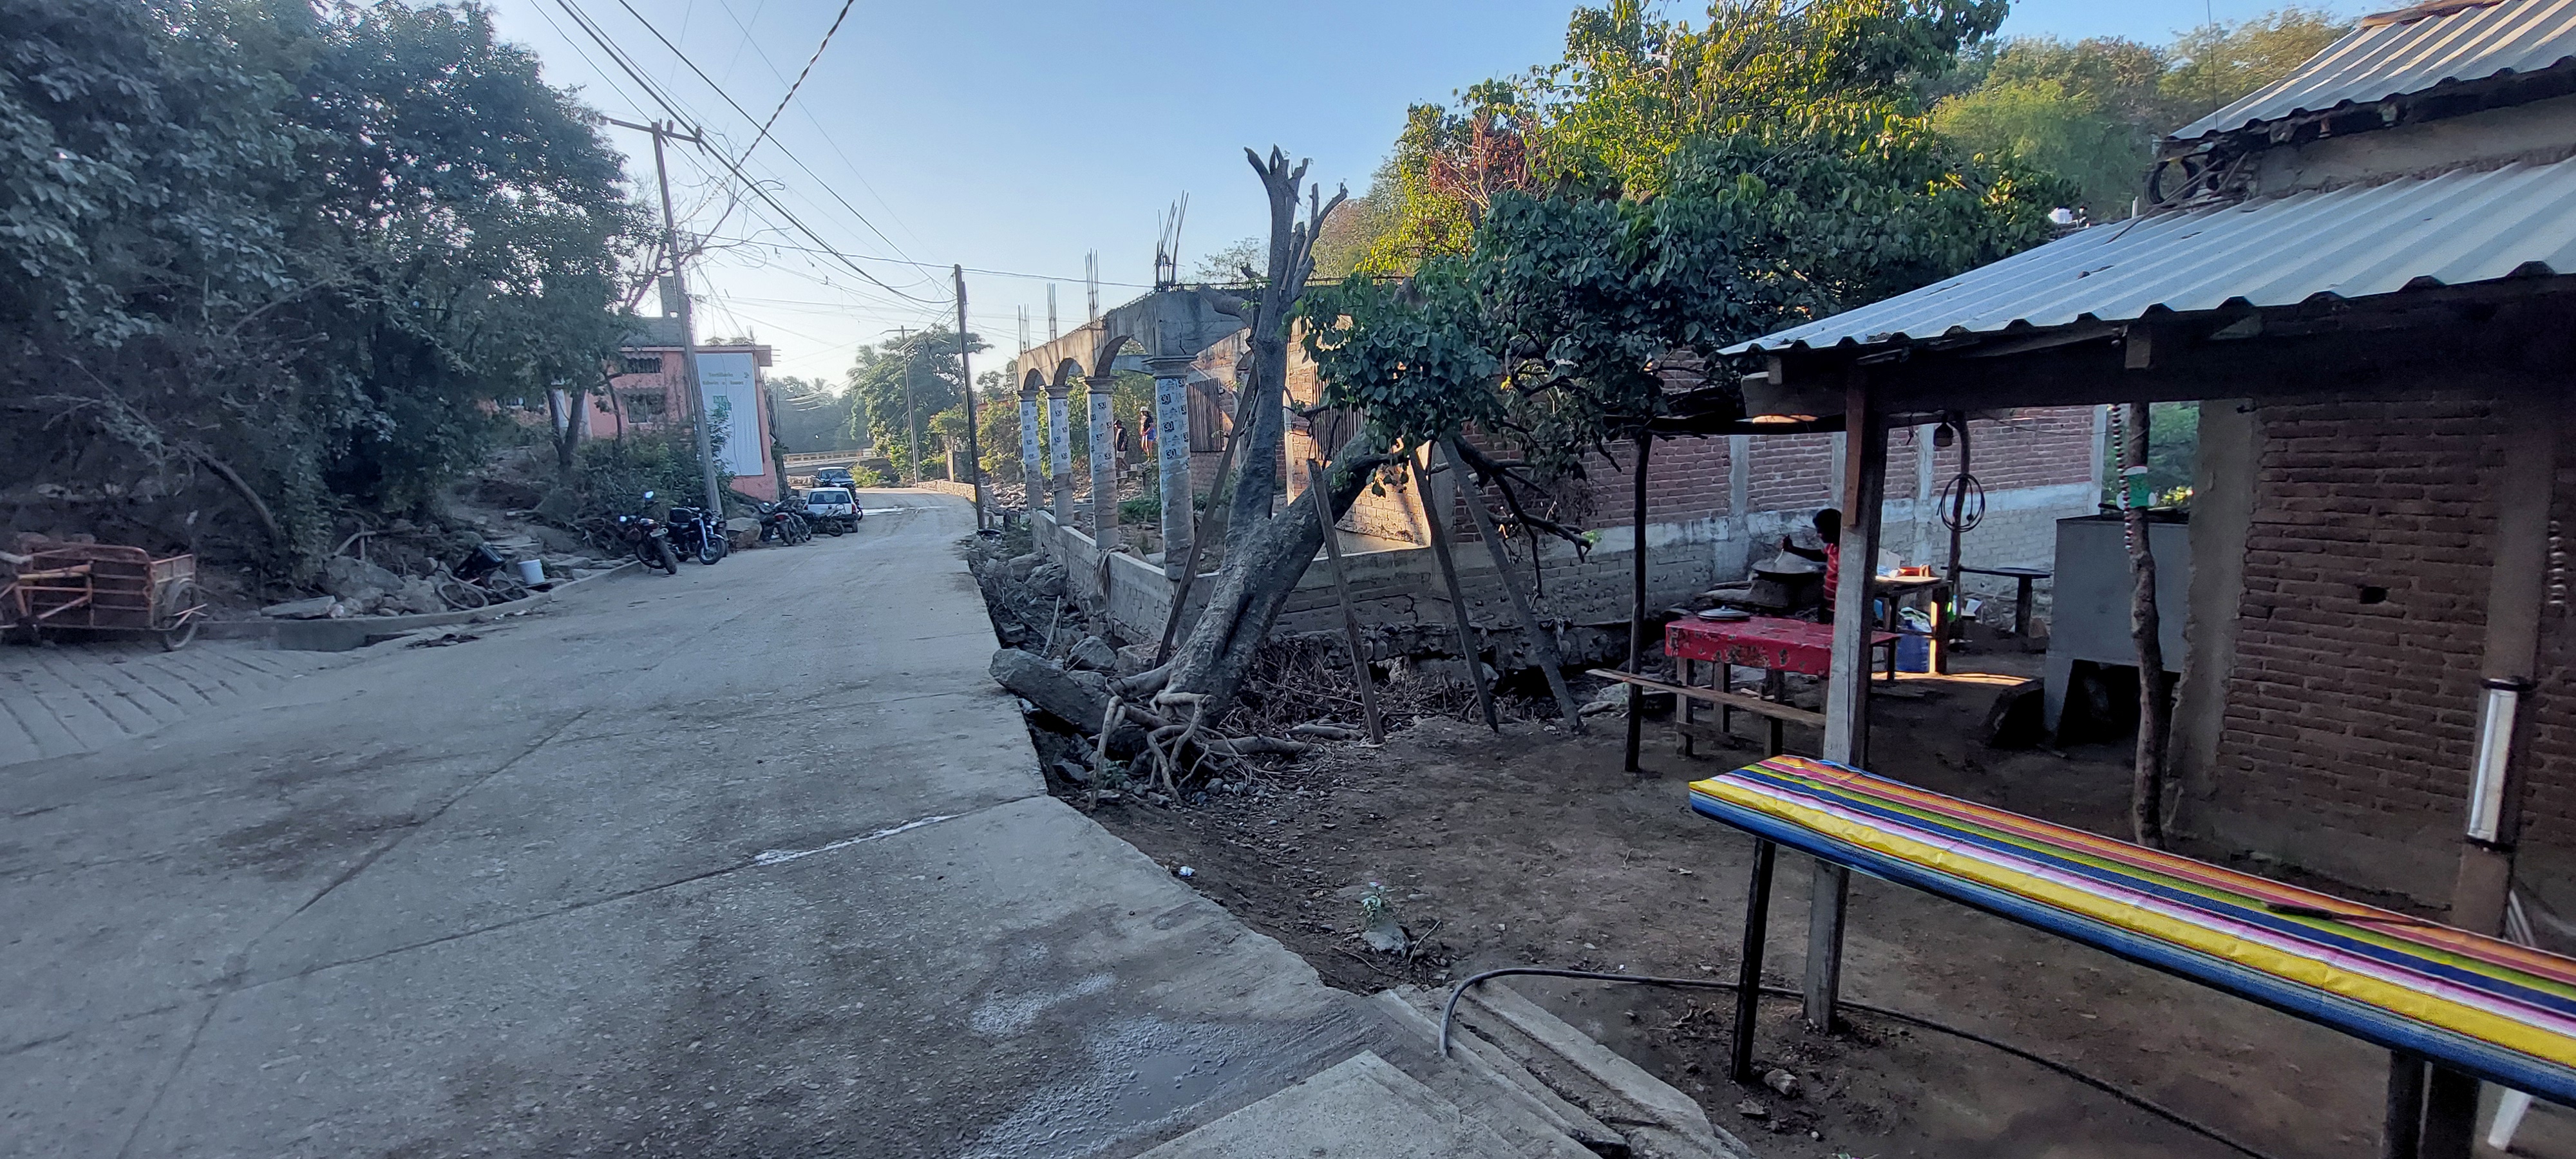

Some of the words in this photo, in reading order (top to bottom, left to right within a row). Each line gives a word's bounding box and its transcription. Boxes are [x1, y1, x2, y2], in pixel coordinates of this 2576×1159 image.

[1160, 394, 1170, 403] 30
[1164, 422, 1173, 431] 30
[1166, 449, 1176, 458] 30
